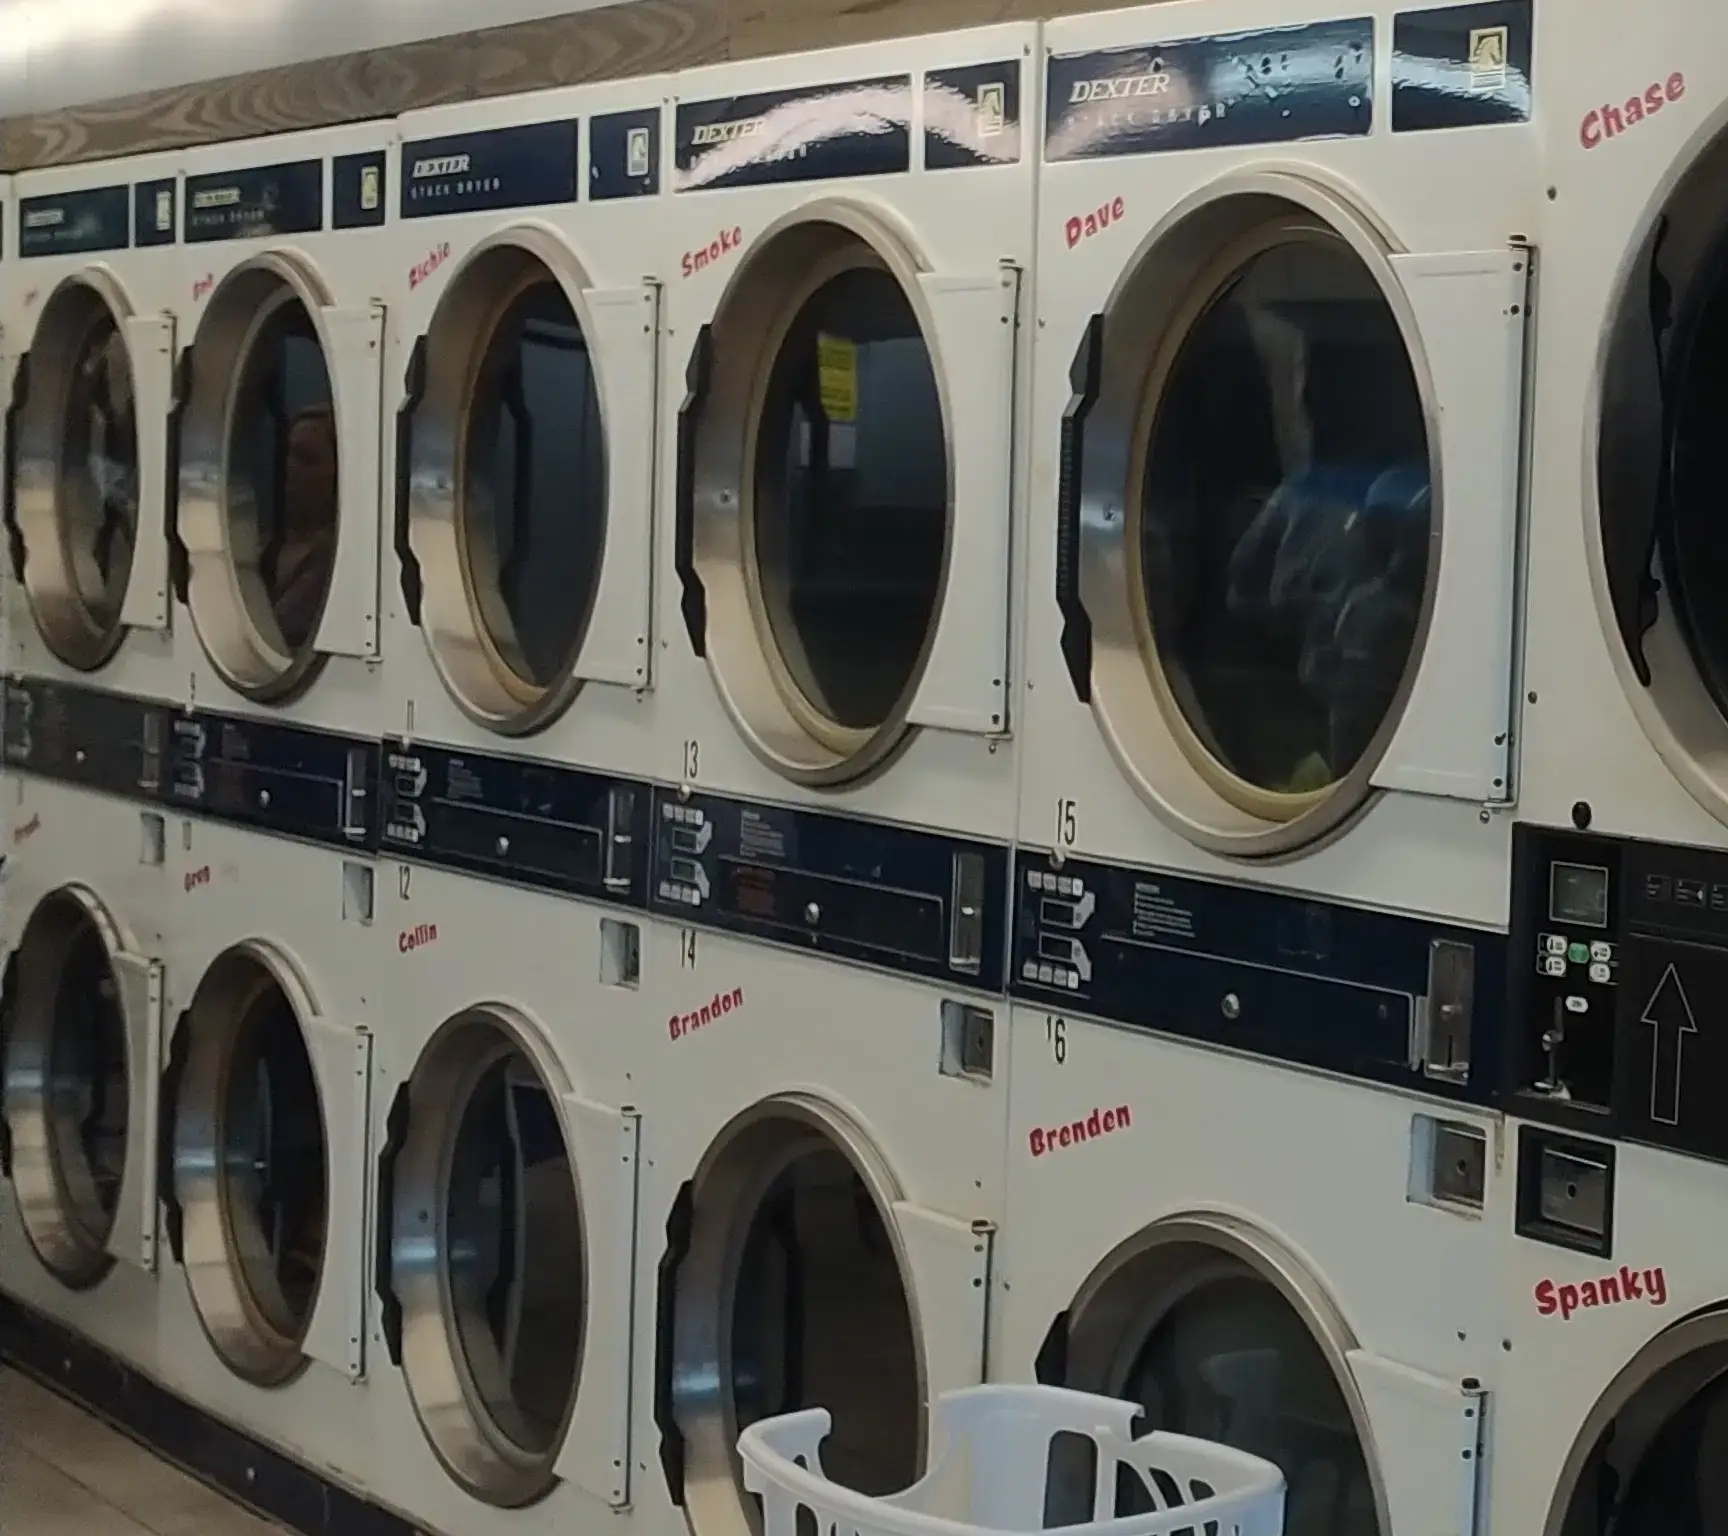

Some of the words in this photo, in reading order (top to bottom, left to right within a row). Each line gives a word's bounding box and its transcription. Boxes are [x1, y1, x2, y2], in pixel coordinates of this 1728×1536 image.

[1069, 73, 1170, 102] DEXTER
[1580, 71, 1686, 150] Chase
[412, 153, 470, 179] DEXTER
[1065, 195, 1125, 250] Dave
[680, 225, 743, 280] Smoke
[684, 740, 699, 780] 13
[1057, 797, 1077, 846] 15
[399, 924, 438, 953] Collin
[681, 929, 696, 971] 14
[668, 986, 744, 1042] Brandon
[1046, 1015, 1067, 1064] 16
[1029, 1104, 1131, 1157] Brenden
[1535, 1266, 1667, 1321] Spanky
